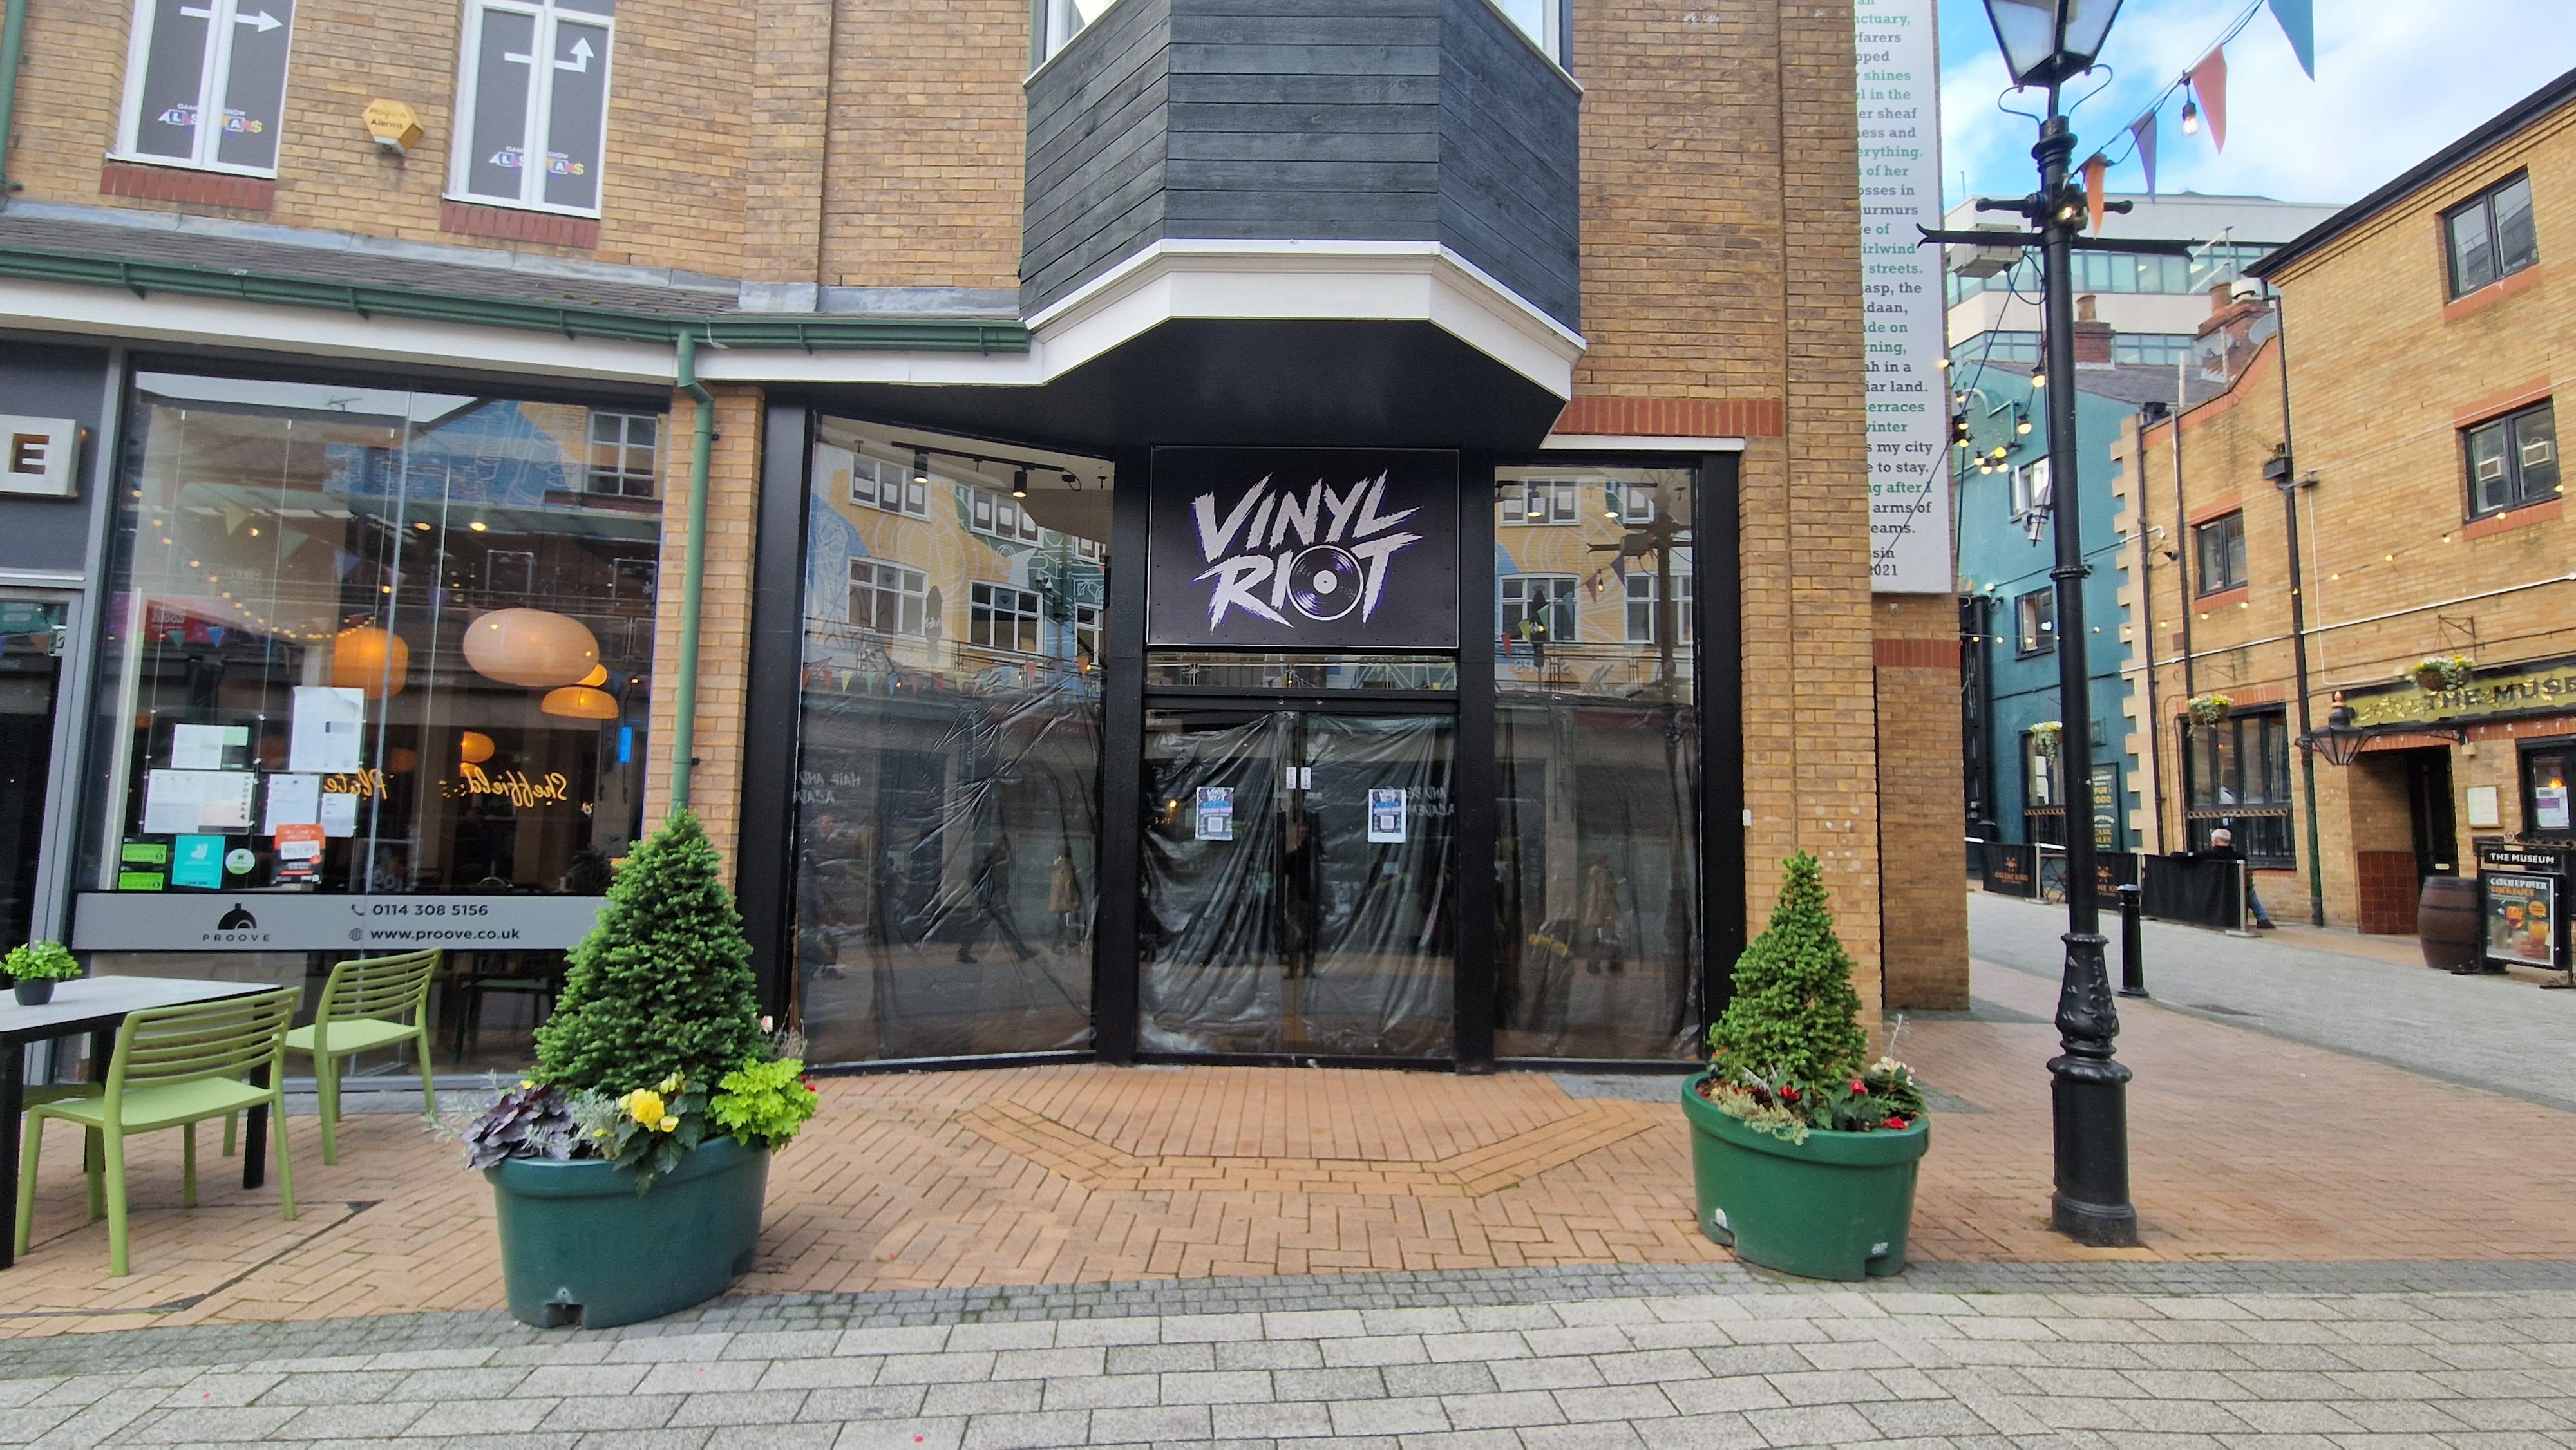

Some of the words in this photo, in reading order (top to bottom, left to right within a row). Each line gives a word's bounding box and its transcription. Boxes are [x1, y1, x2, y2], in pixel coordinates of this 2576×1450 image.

[1855, 32, 1902, 43] farers
[1864, 70, 1911, 81] shines
[1870, 88, 1884, 100] in
[1888, 88, 1911, 100] the
[1877, 107, 1918, 118] sheaf
[1857, 129, 1885, 138] ess
[1889, 127, 1917, 138] and
[1866, 165, 1881, 176] of
[1884, 165, 1909, 176] her
[1900, 185, 1915, 196] in
[1861, 206, 1918, 215] urmurs
[1875, 223, 1890, 234] of
[1868, 263, 1923, 274] streets.
[1864, 284, 1894, 296] asp,
[1899, 282, 1922, 294] the
[1863, 302, 1908, 315] daan,
[1890, 324, 1908, 333] on
[1884, 361, 1899, 372] in
[1903, 363, 1911, 372] a
[1891, 381, 1928, 392] land.
[1877, 443, 1900, 456] my
[1905, 440, 1933, 456] city
[8, 433, 50, 475] E
[1878, 462, 1891, 473] to
[1896, 462, 1929, 476] stay.
[1887, 481, 1922, 493] after
[1873, 504, 1913, 513] arms
[1917, 501, 1933, 513] of
[1190, 466, 1424, 564] VINYL
[1870, 547, 1895, 558] sin
[1870, 563, 1898, 576] 021
[1190, 531, 1423, 636] RIOT
[2490, 852, 2510, 862] THE
[2512, 854, 2555, 865] MUSEUM
[372, 905, 408, 916] 0114
[415, 905, 446, 916] 308
[452, 905, 488, 916] 5156
[202, 934, 270, 942] PROOVE
[371, 927, 520, 942] www.proove.co.uk
